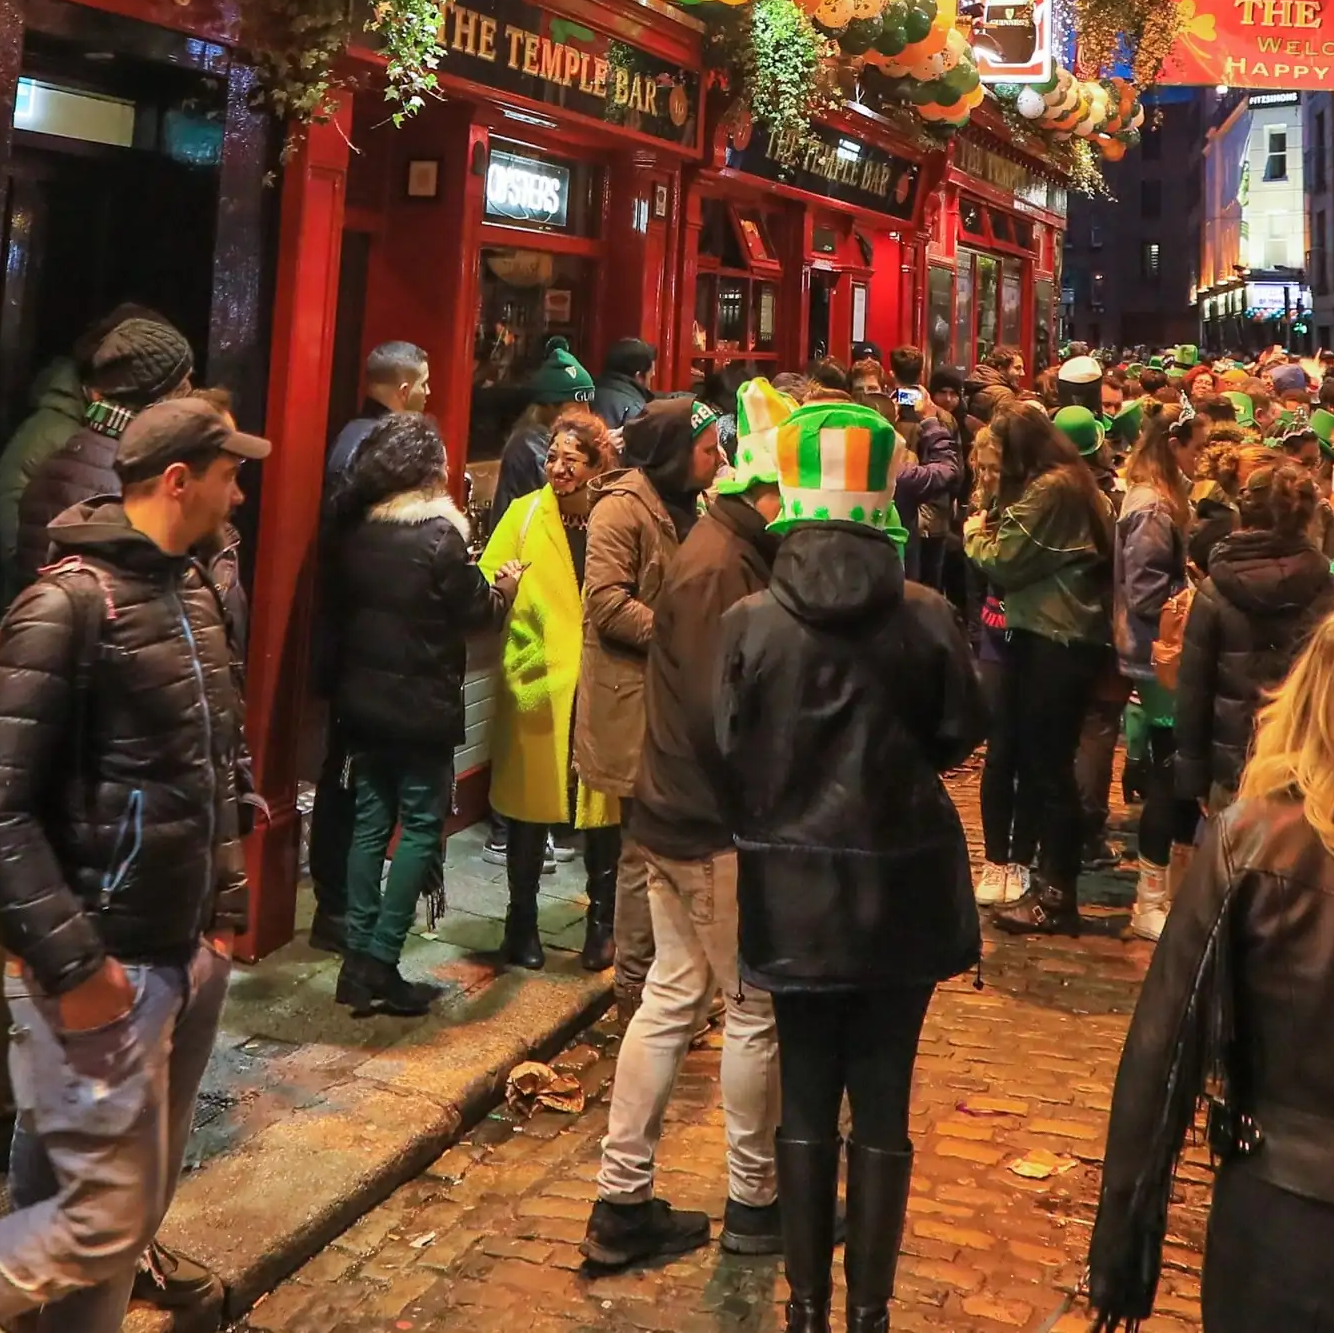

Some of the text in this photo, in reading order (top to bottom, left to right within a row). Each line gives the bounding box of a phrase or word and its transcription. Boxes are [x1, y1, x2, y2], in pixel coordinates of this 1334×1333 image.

[505, 23, 610, 100] TEMPLE
[614, 70, 658, 117] BAR
[1226, 56, 1329, 81] HAPPY
